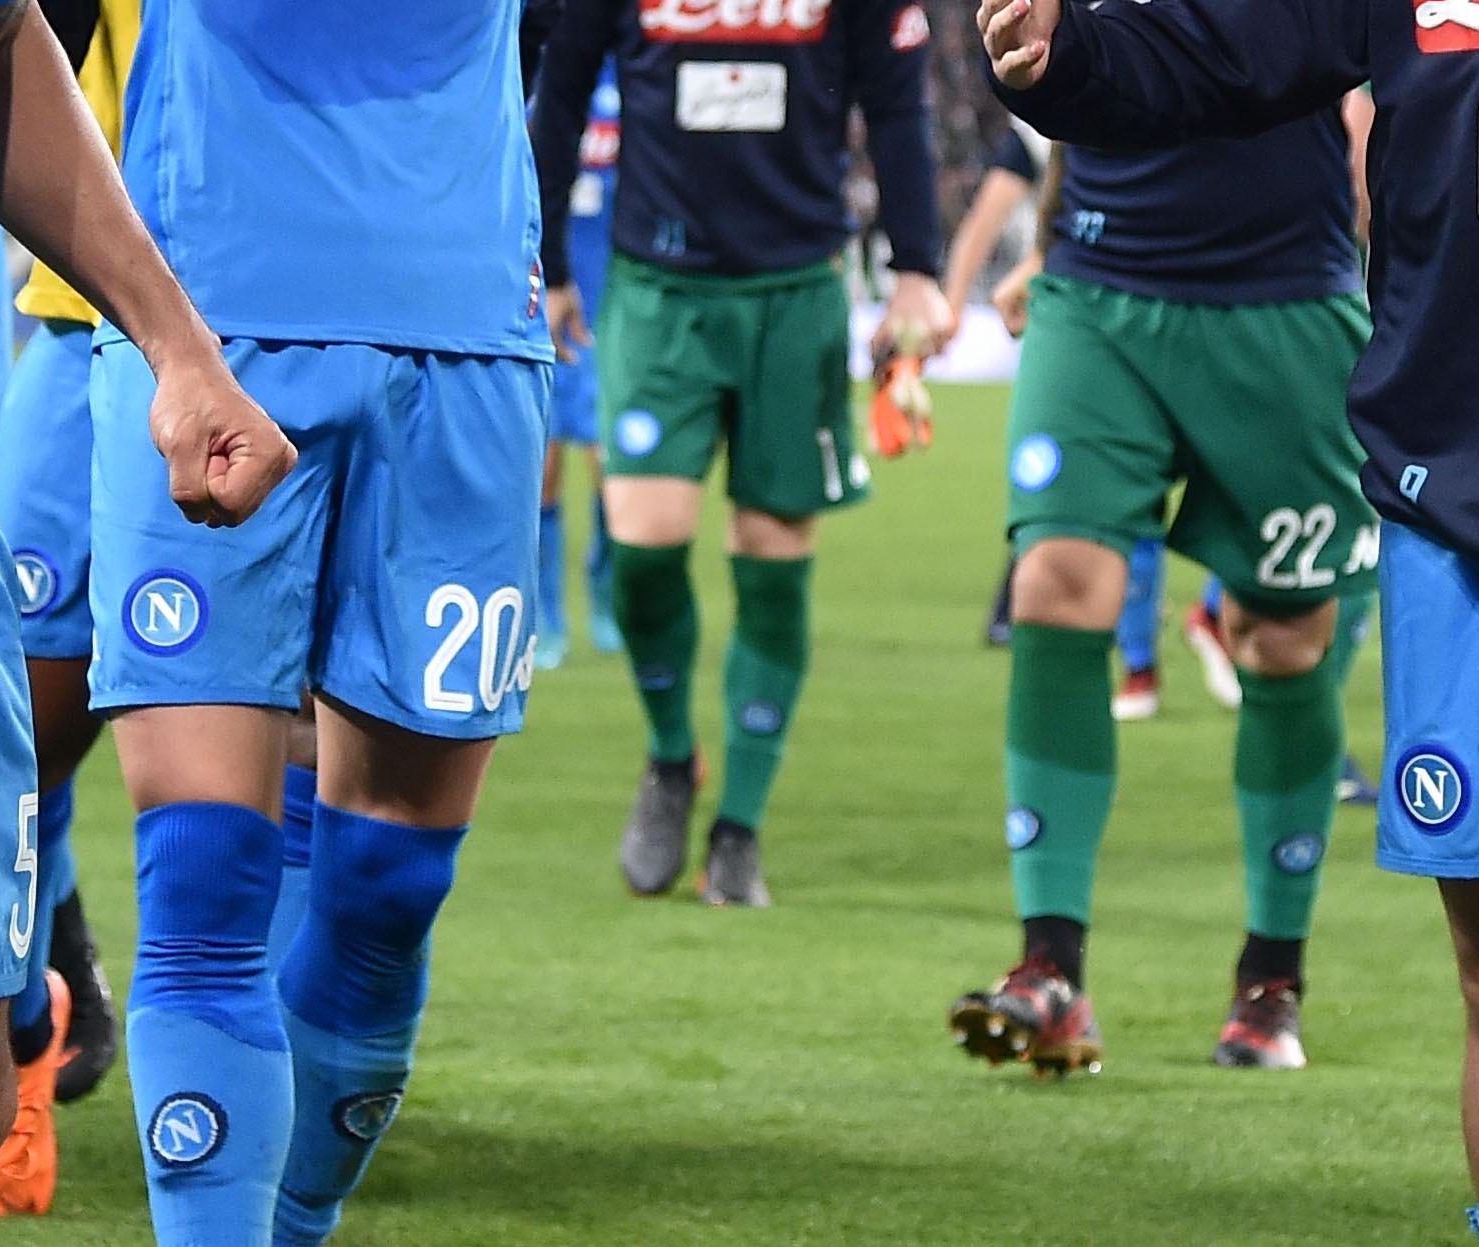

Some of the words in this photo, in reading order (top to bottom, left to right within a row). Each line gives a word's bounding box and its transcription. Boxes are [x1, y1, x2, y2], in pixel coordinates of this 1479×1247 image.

[1258, 503, 1337, 589] 22
[148, 592, 184, 632] N
[424, 584, 524, 713] 20
[1411, 767, 1446, 814] N
[164, 1111, 201, 1153] N
